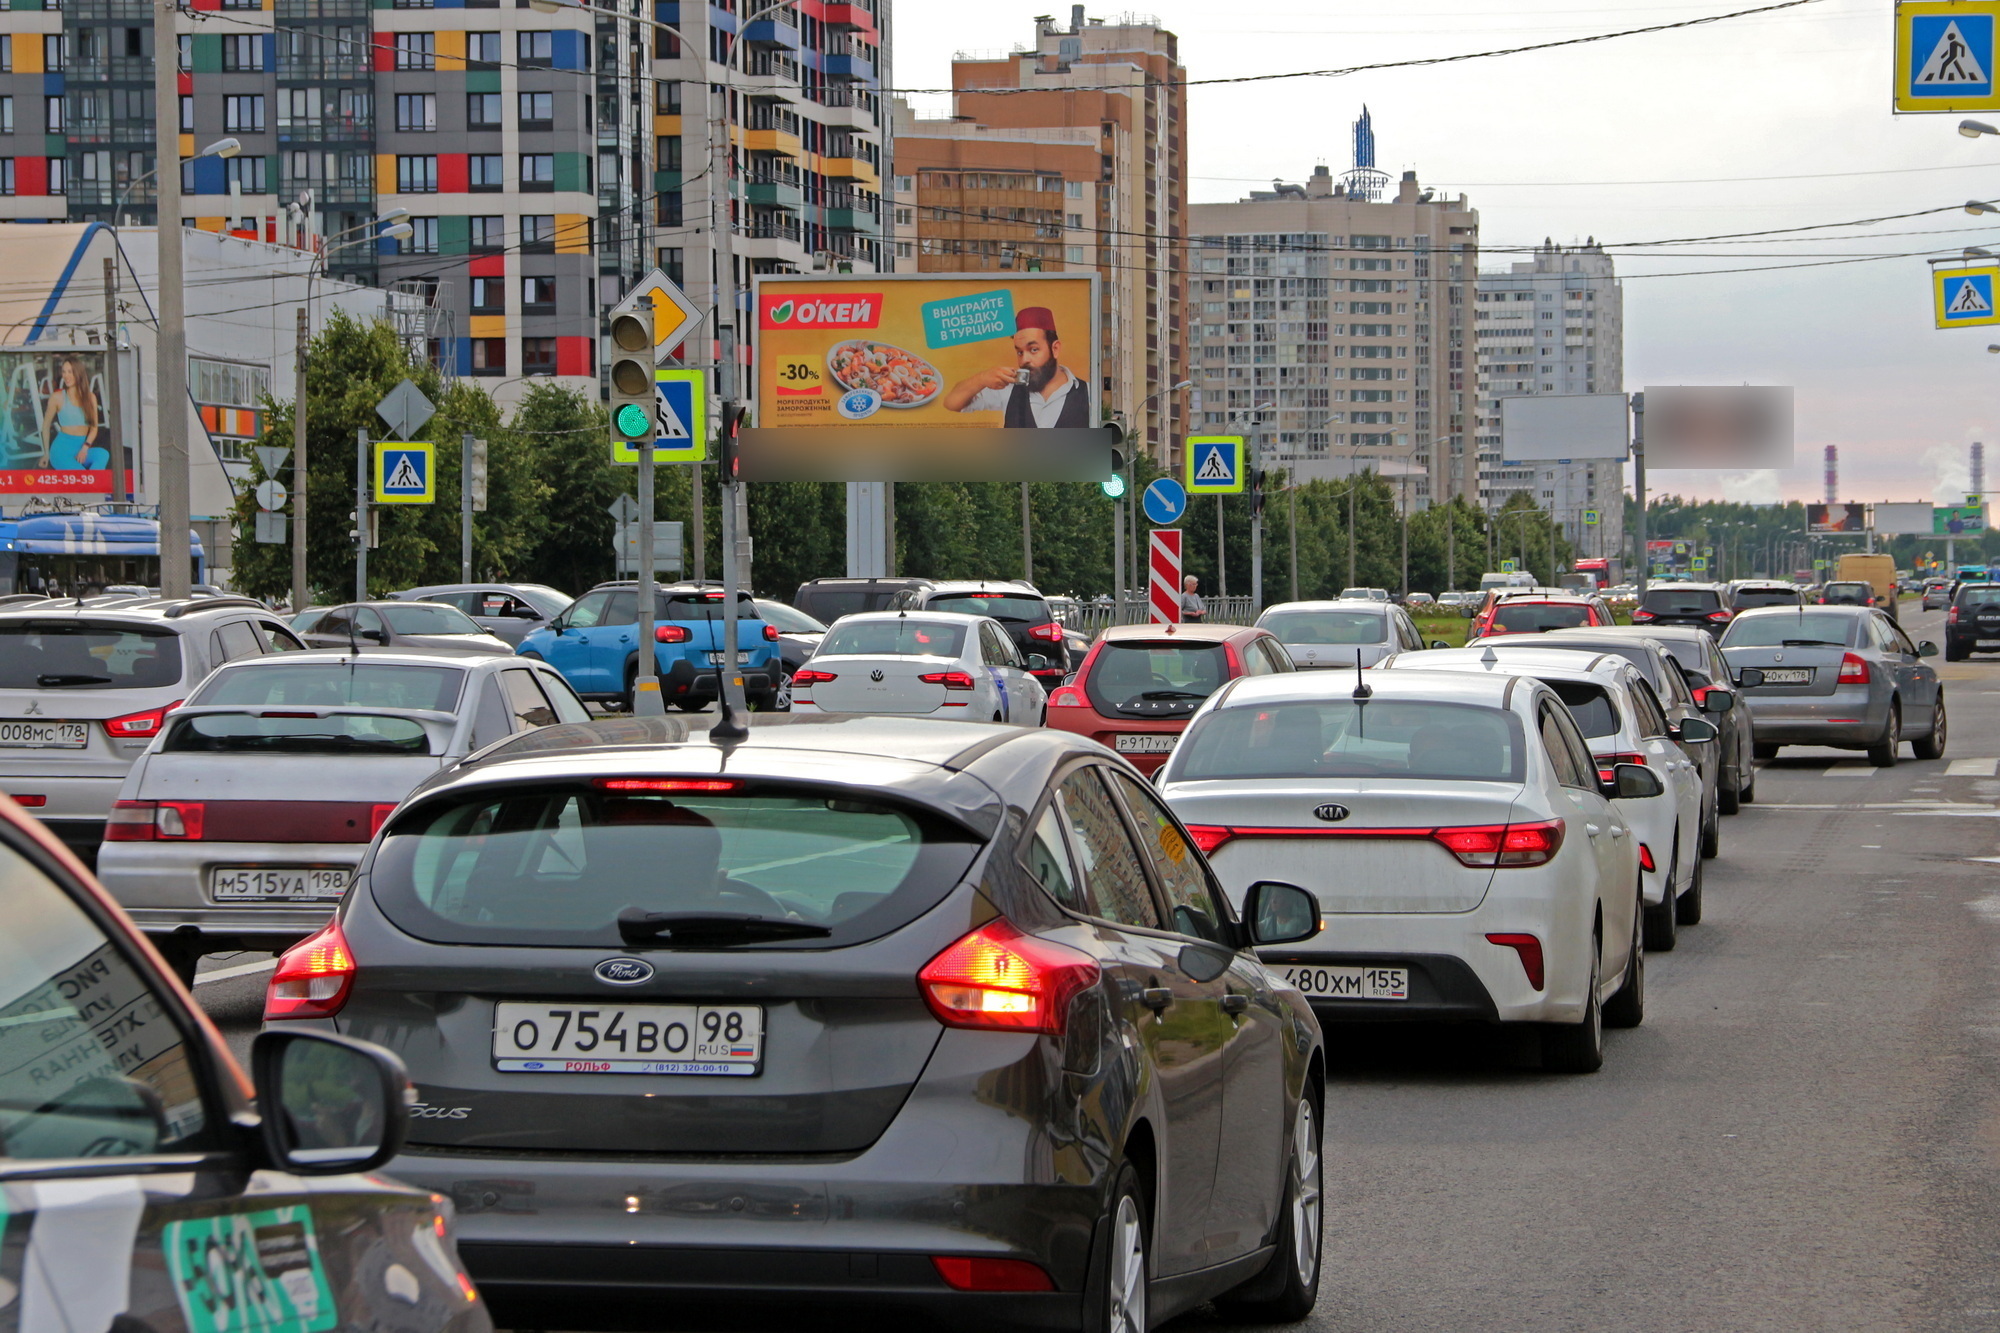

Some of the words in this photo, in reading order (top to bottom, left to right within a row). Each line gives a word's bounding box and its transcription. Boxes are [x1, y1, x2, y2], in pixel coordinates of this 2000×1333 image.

[1342, 176, 1389, 188] ЛИДЕР
[933, 297, 1004, 318] ВЫИГРАЙТЕ
[942, 310, 999, 329] ПОЕЗДКУ
[940, 331, 948, 340] В
[950, 321, 1004, 339] ТУРЦИЮ
[780, 364, 820, 380] -30%
[37, 475, 95, 484] 425-39-39
[1765, 671, 1789, 680] 40КУ
[1, 724, 54, 741] 008МС
[58, 725, 82, 737] 178
[1319, 807, 1344, 818] KIA
[220, 872, 305, 894] М515УА
[312, 872, 343, 888] 198
[608, 963, 640, 978] Ford
[1284, 968, 1361, 994] 480ХМ
[1366, 970, 1402, 988] 155
[703, 1011, 744, 1043] 98
[698, 1044, 729, 1056] RUS
[565, 1062, 611, 1072] РОЛЬФ
[655, 1063, 679, 1072] (812)
[683, 1064, 729, 1072] 320-00-10
